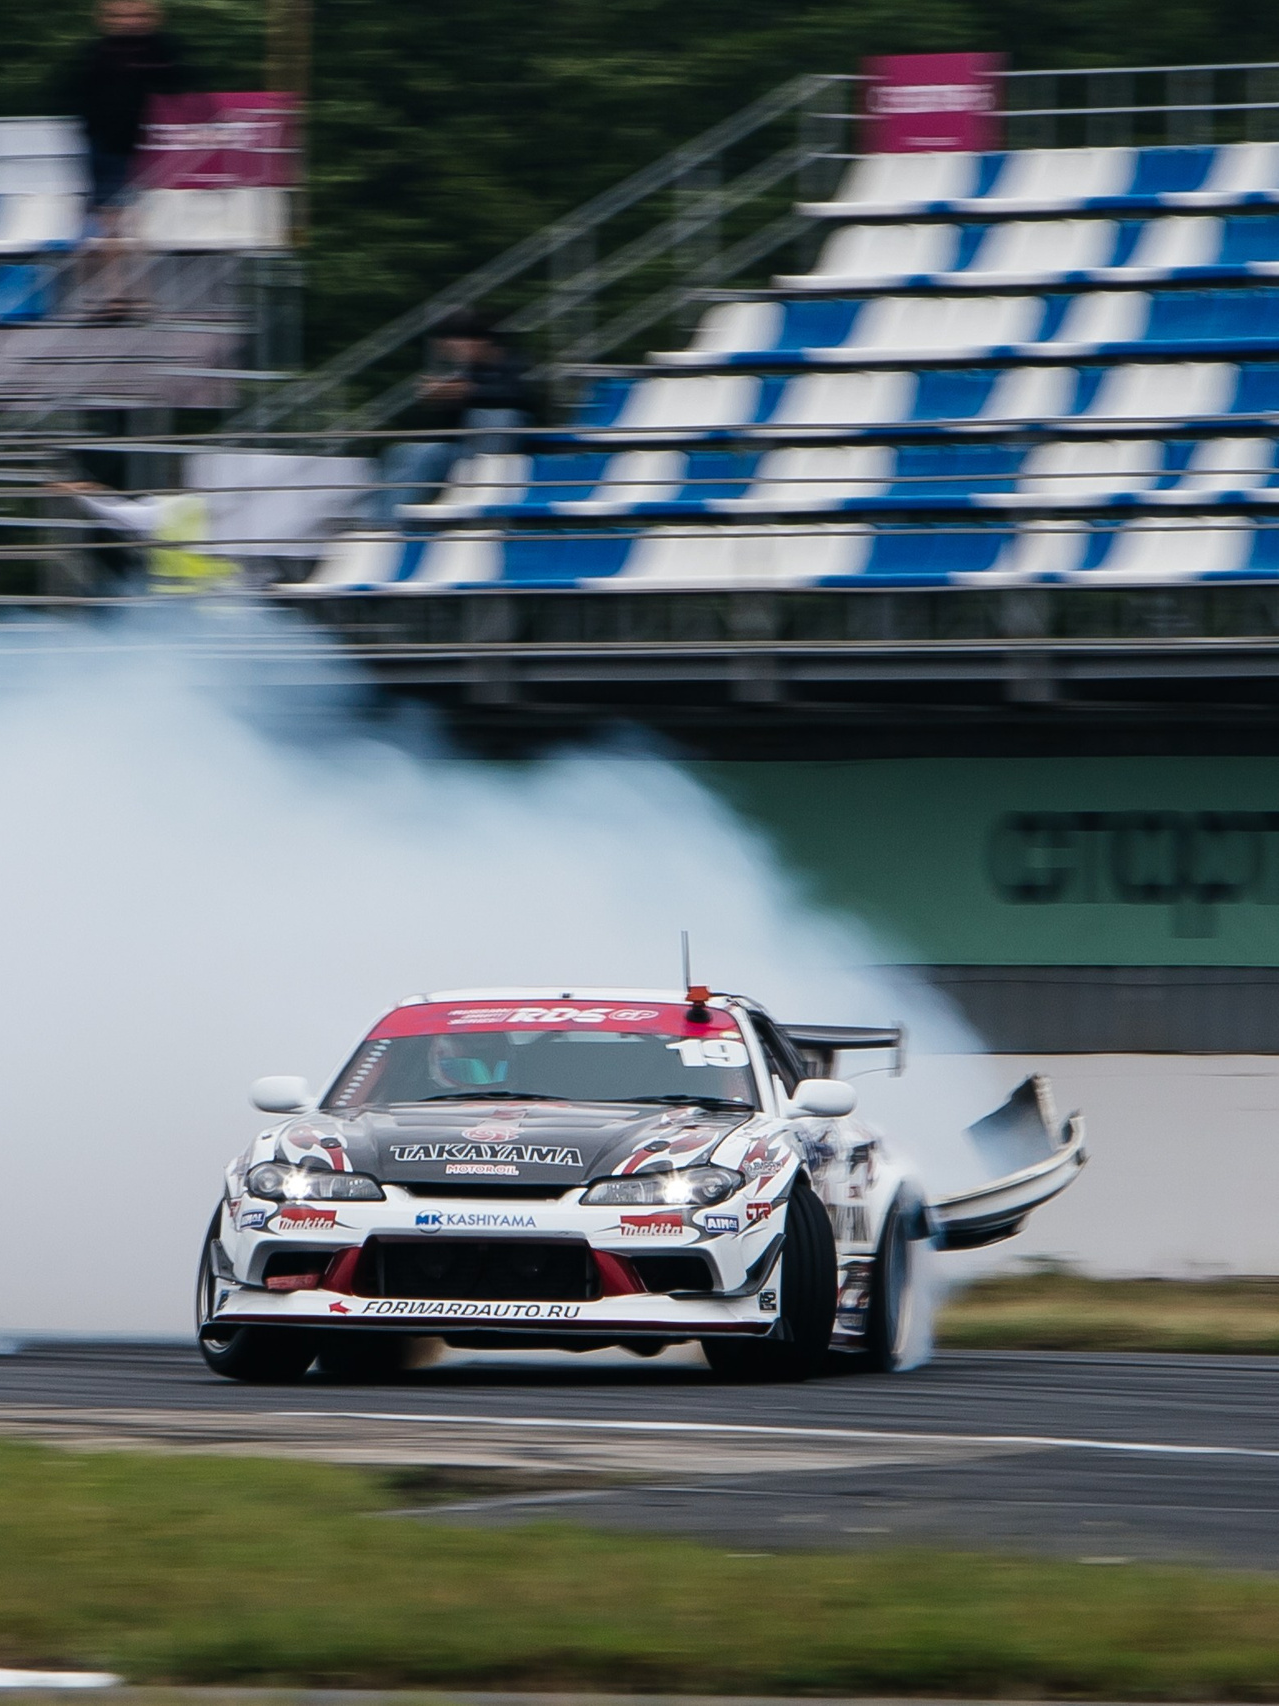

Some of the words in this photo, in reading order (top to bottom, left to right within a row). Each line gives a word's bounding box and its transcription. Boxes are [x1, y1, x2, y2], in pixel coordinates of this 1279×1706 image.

[507, 1007, 613, 1024] RDS
[611, 1009, 656, 1022] GP
[665, 1039, 750, 1067] 19
[390, 1143, 584, 1167] TAKAYAMA
[415, 1214, 443, 1226] MK
[446, 1213, 537, 1228] KASHIYAMA
[362, 1301, 581, 1319] FORWARDAUTO.RU
